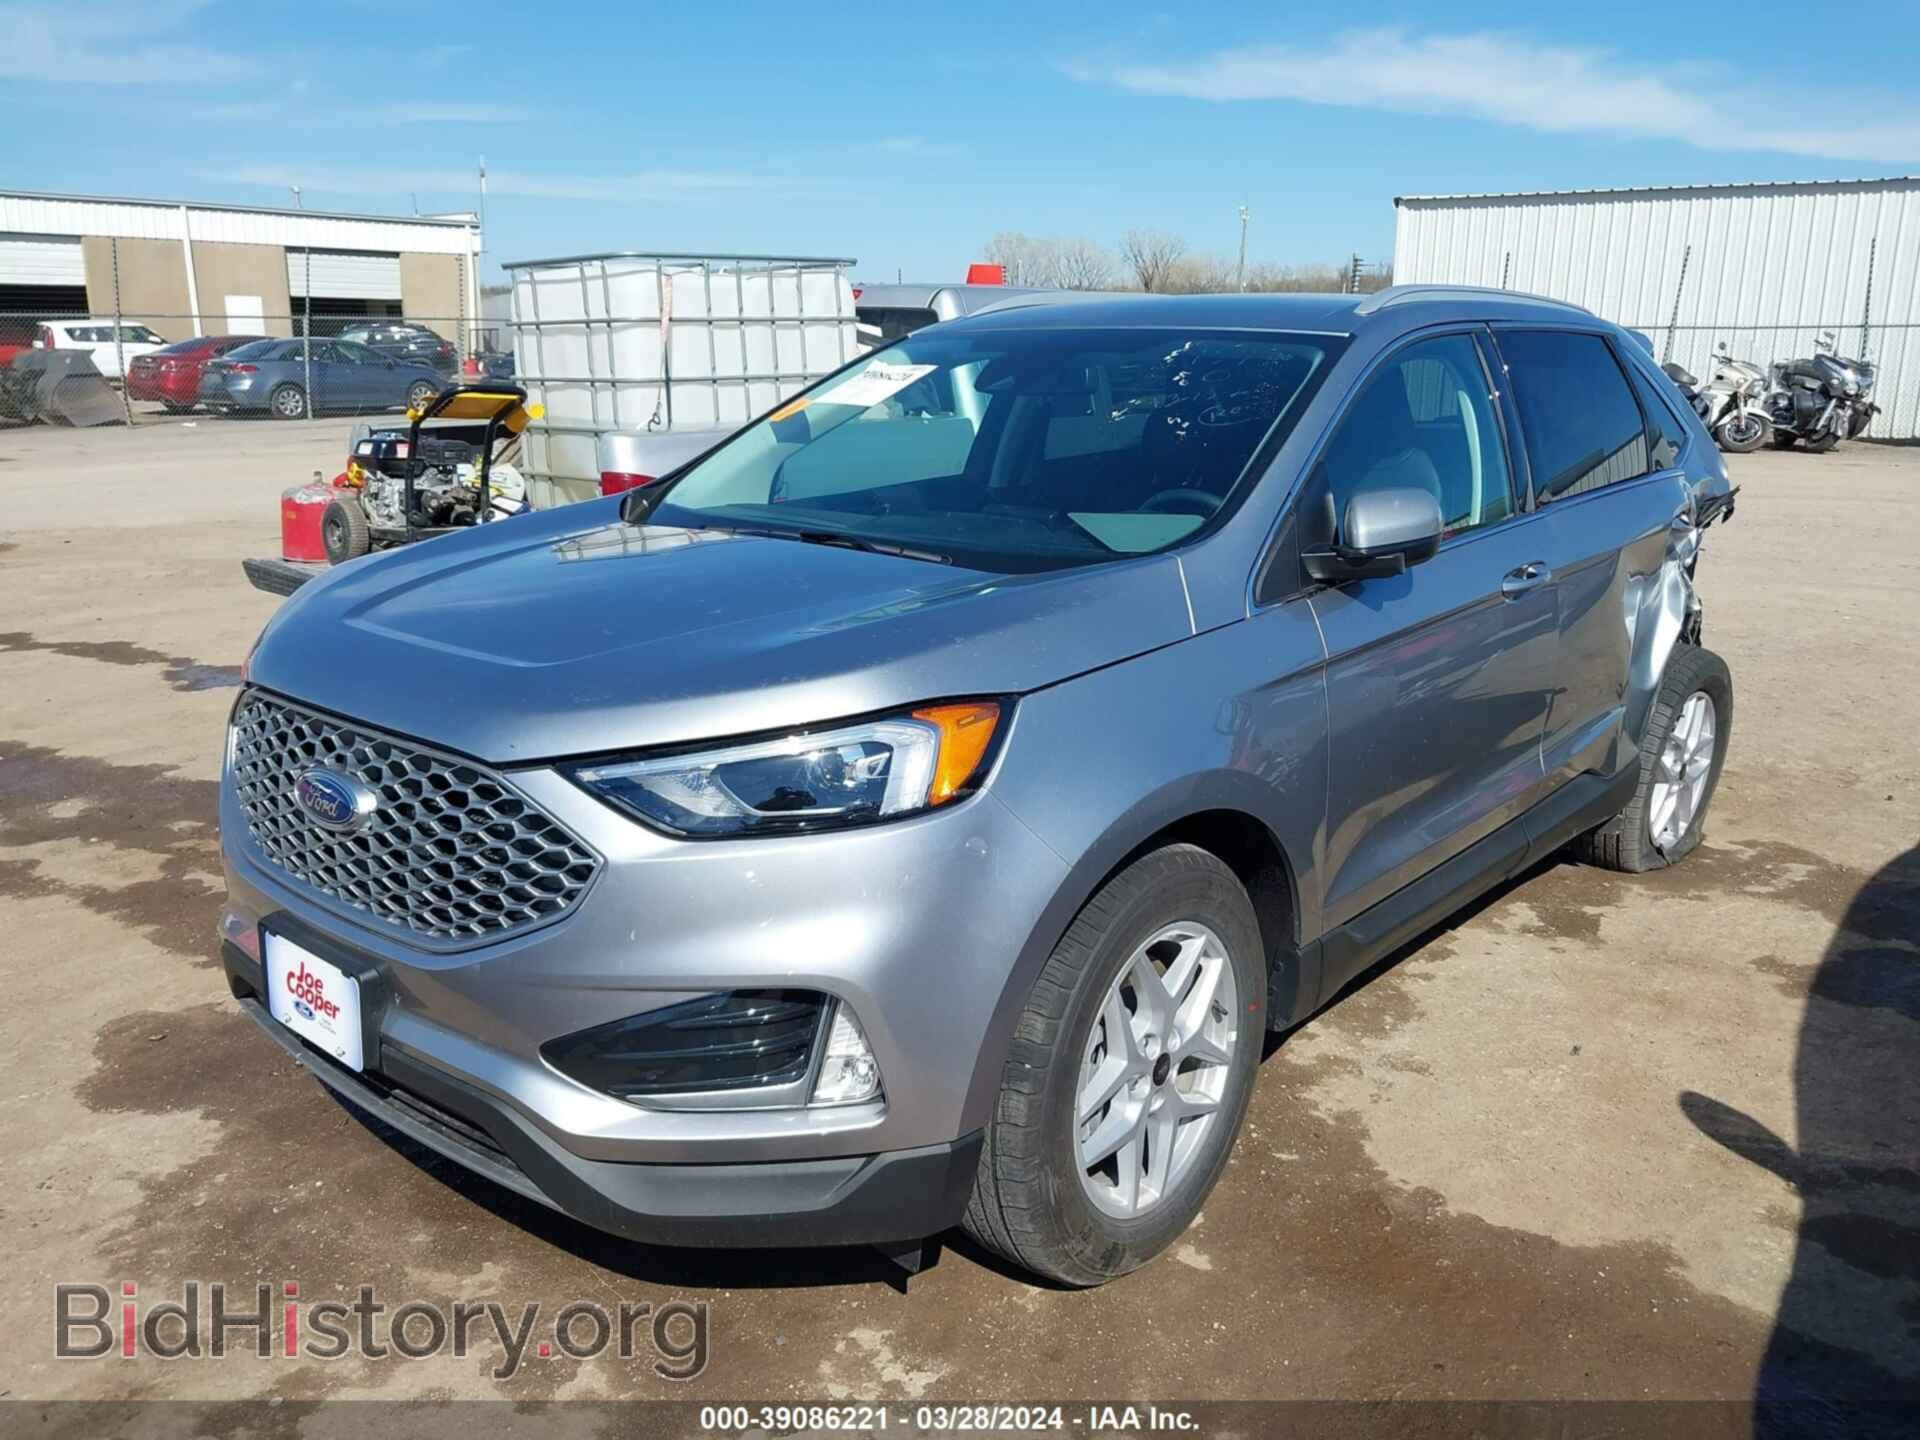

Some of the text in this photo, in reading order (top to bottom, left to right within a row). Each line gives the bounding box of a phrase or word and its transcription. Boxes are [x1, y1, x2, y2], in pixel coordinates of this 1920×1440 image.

[304, 782, 340, 817] Ford
[286, 970, 341, 1020] Cooper
[296, 961, 324, 995] Joe
